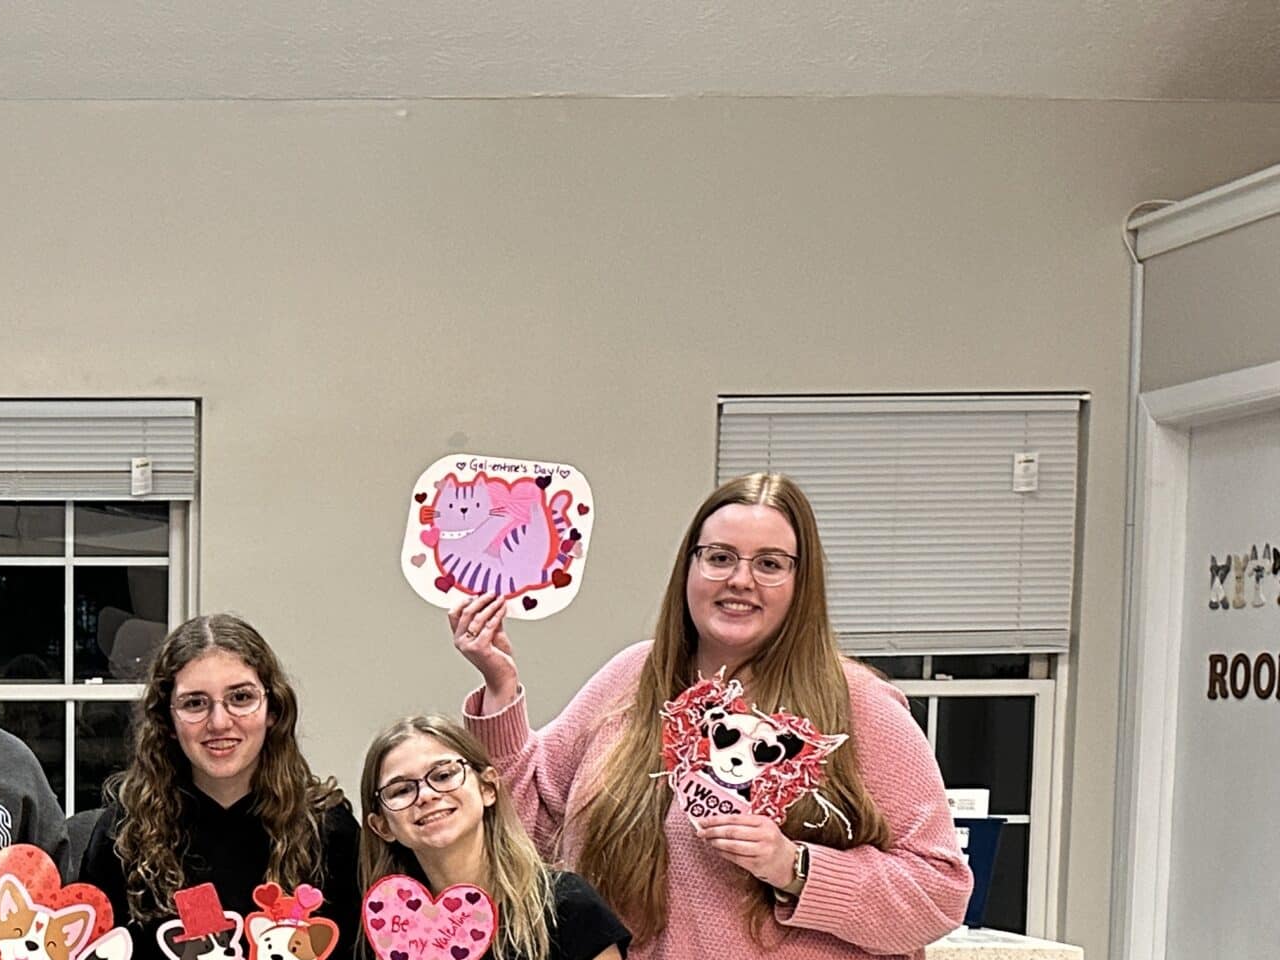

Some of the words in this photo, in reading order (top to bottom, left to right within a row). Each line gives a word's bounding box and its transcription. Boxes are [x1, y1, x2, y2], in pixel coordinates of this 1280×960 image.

[1208, 542, 1280, 610] KIT
[1207, 653, 1280, 700] ROO
[392, 915, 410, 933] Be
[432, 911, 471, 950] Valentine
[409, 938, 428, 955] my
